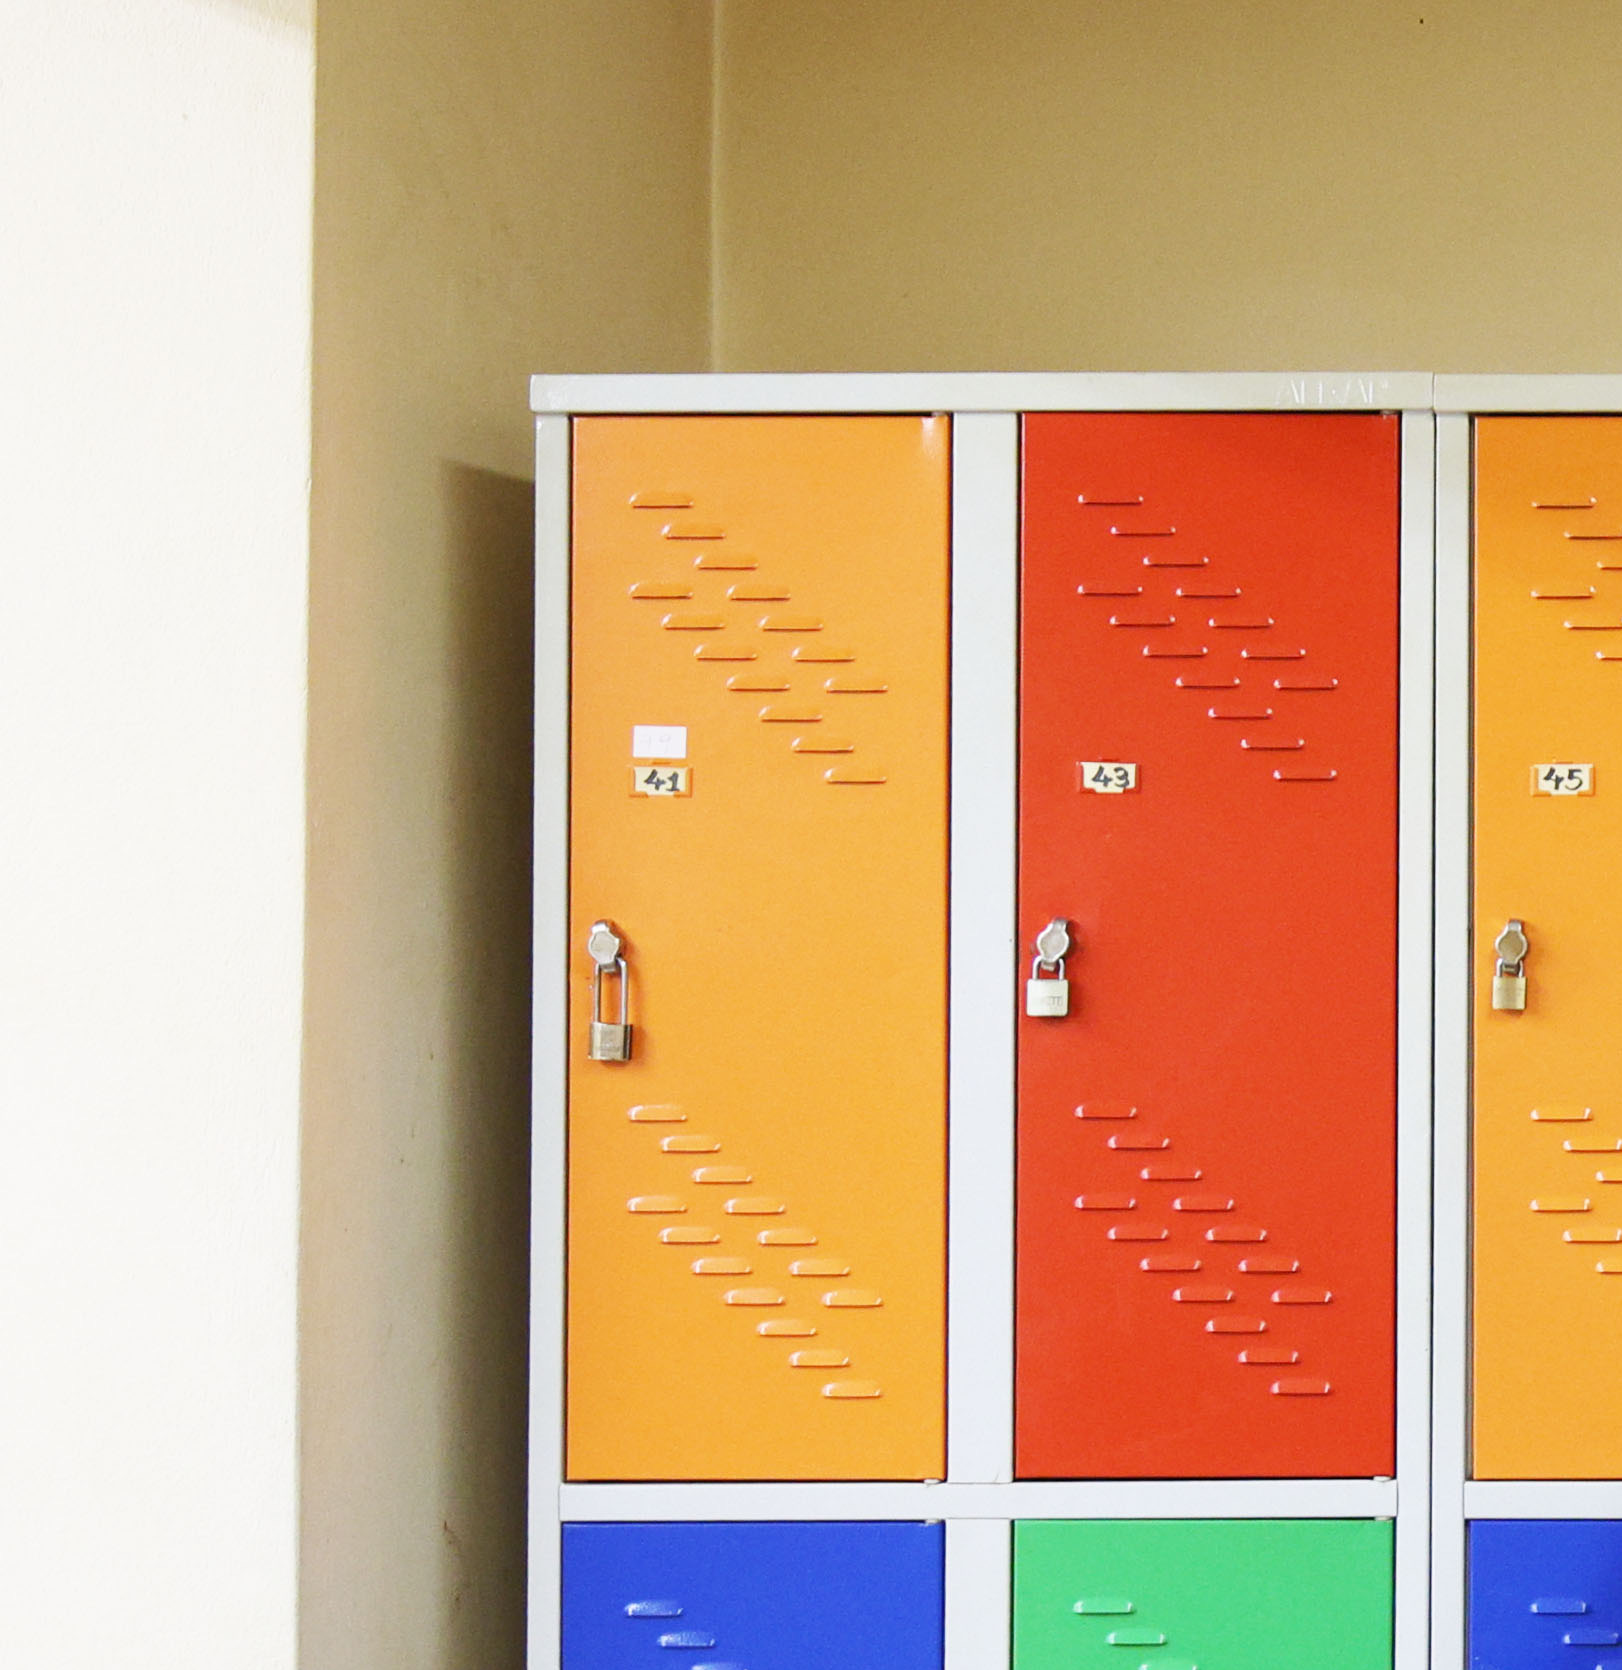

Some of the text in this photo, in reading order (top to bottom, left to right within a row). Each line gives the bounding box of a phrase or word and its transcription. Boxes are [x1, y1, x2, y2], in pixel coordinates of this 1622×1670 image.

[644, 769, 681, 792] 41
[1091, 766, 1131, 789] 43
[1543, 767, 1584, 791] 45
